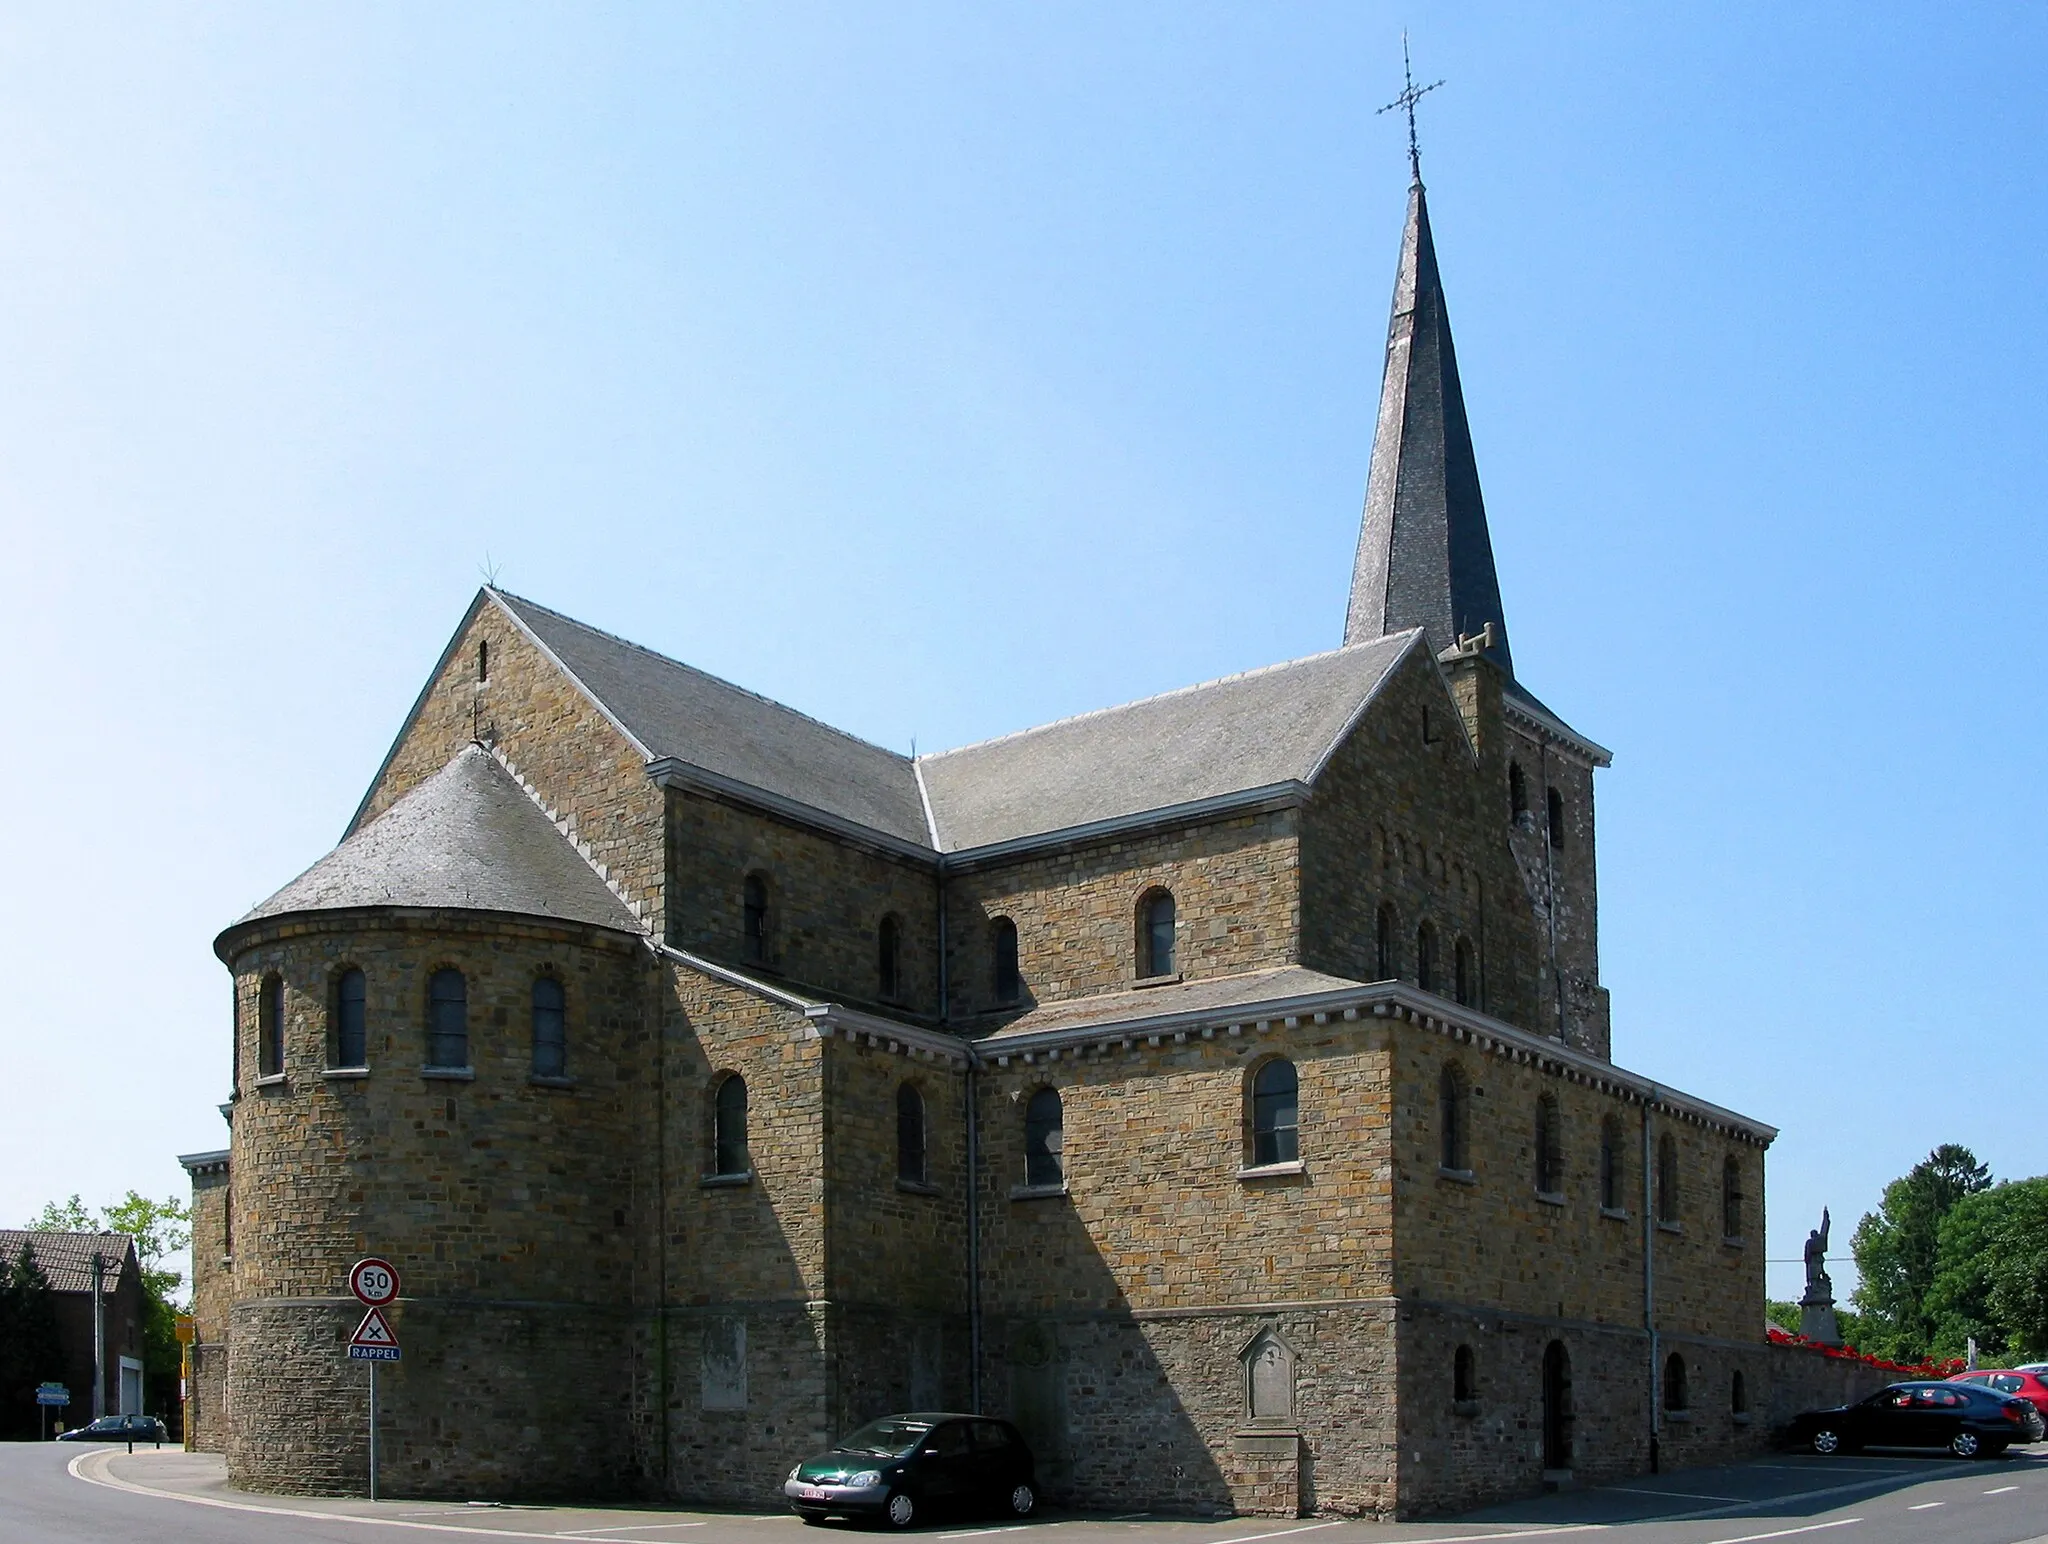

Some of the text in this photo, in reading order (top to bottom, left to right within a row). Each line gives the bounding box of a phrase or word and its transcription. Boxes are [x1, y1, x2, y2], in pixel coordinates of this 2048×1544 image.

[364, 1272, 389, 1288] 50
[368, 1289, 383, 1297] km
[352, 1347, 397, 1359] RAPPEL
